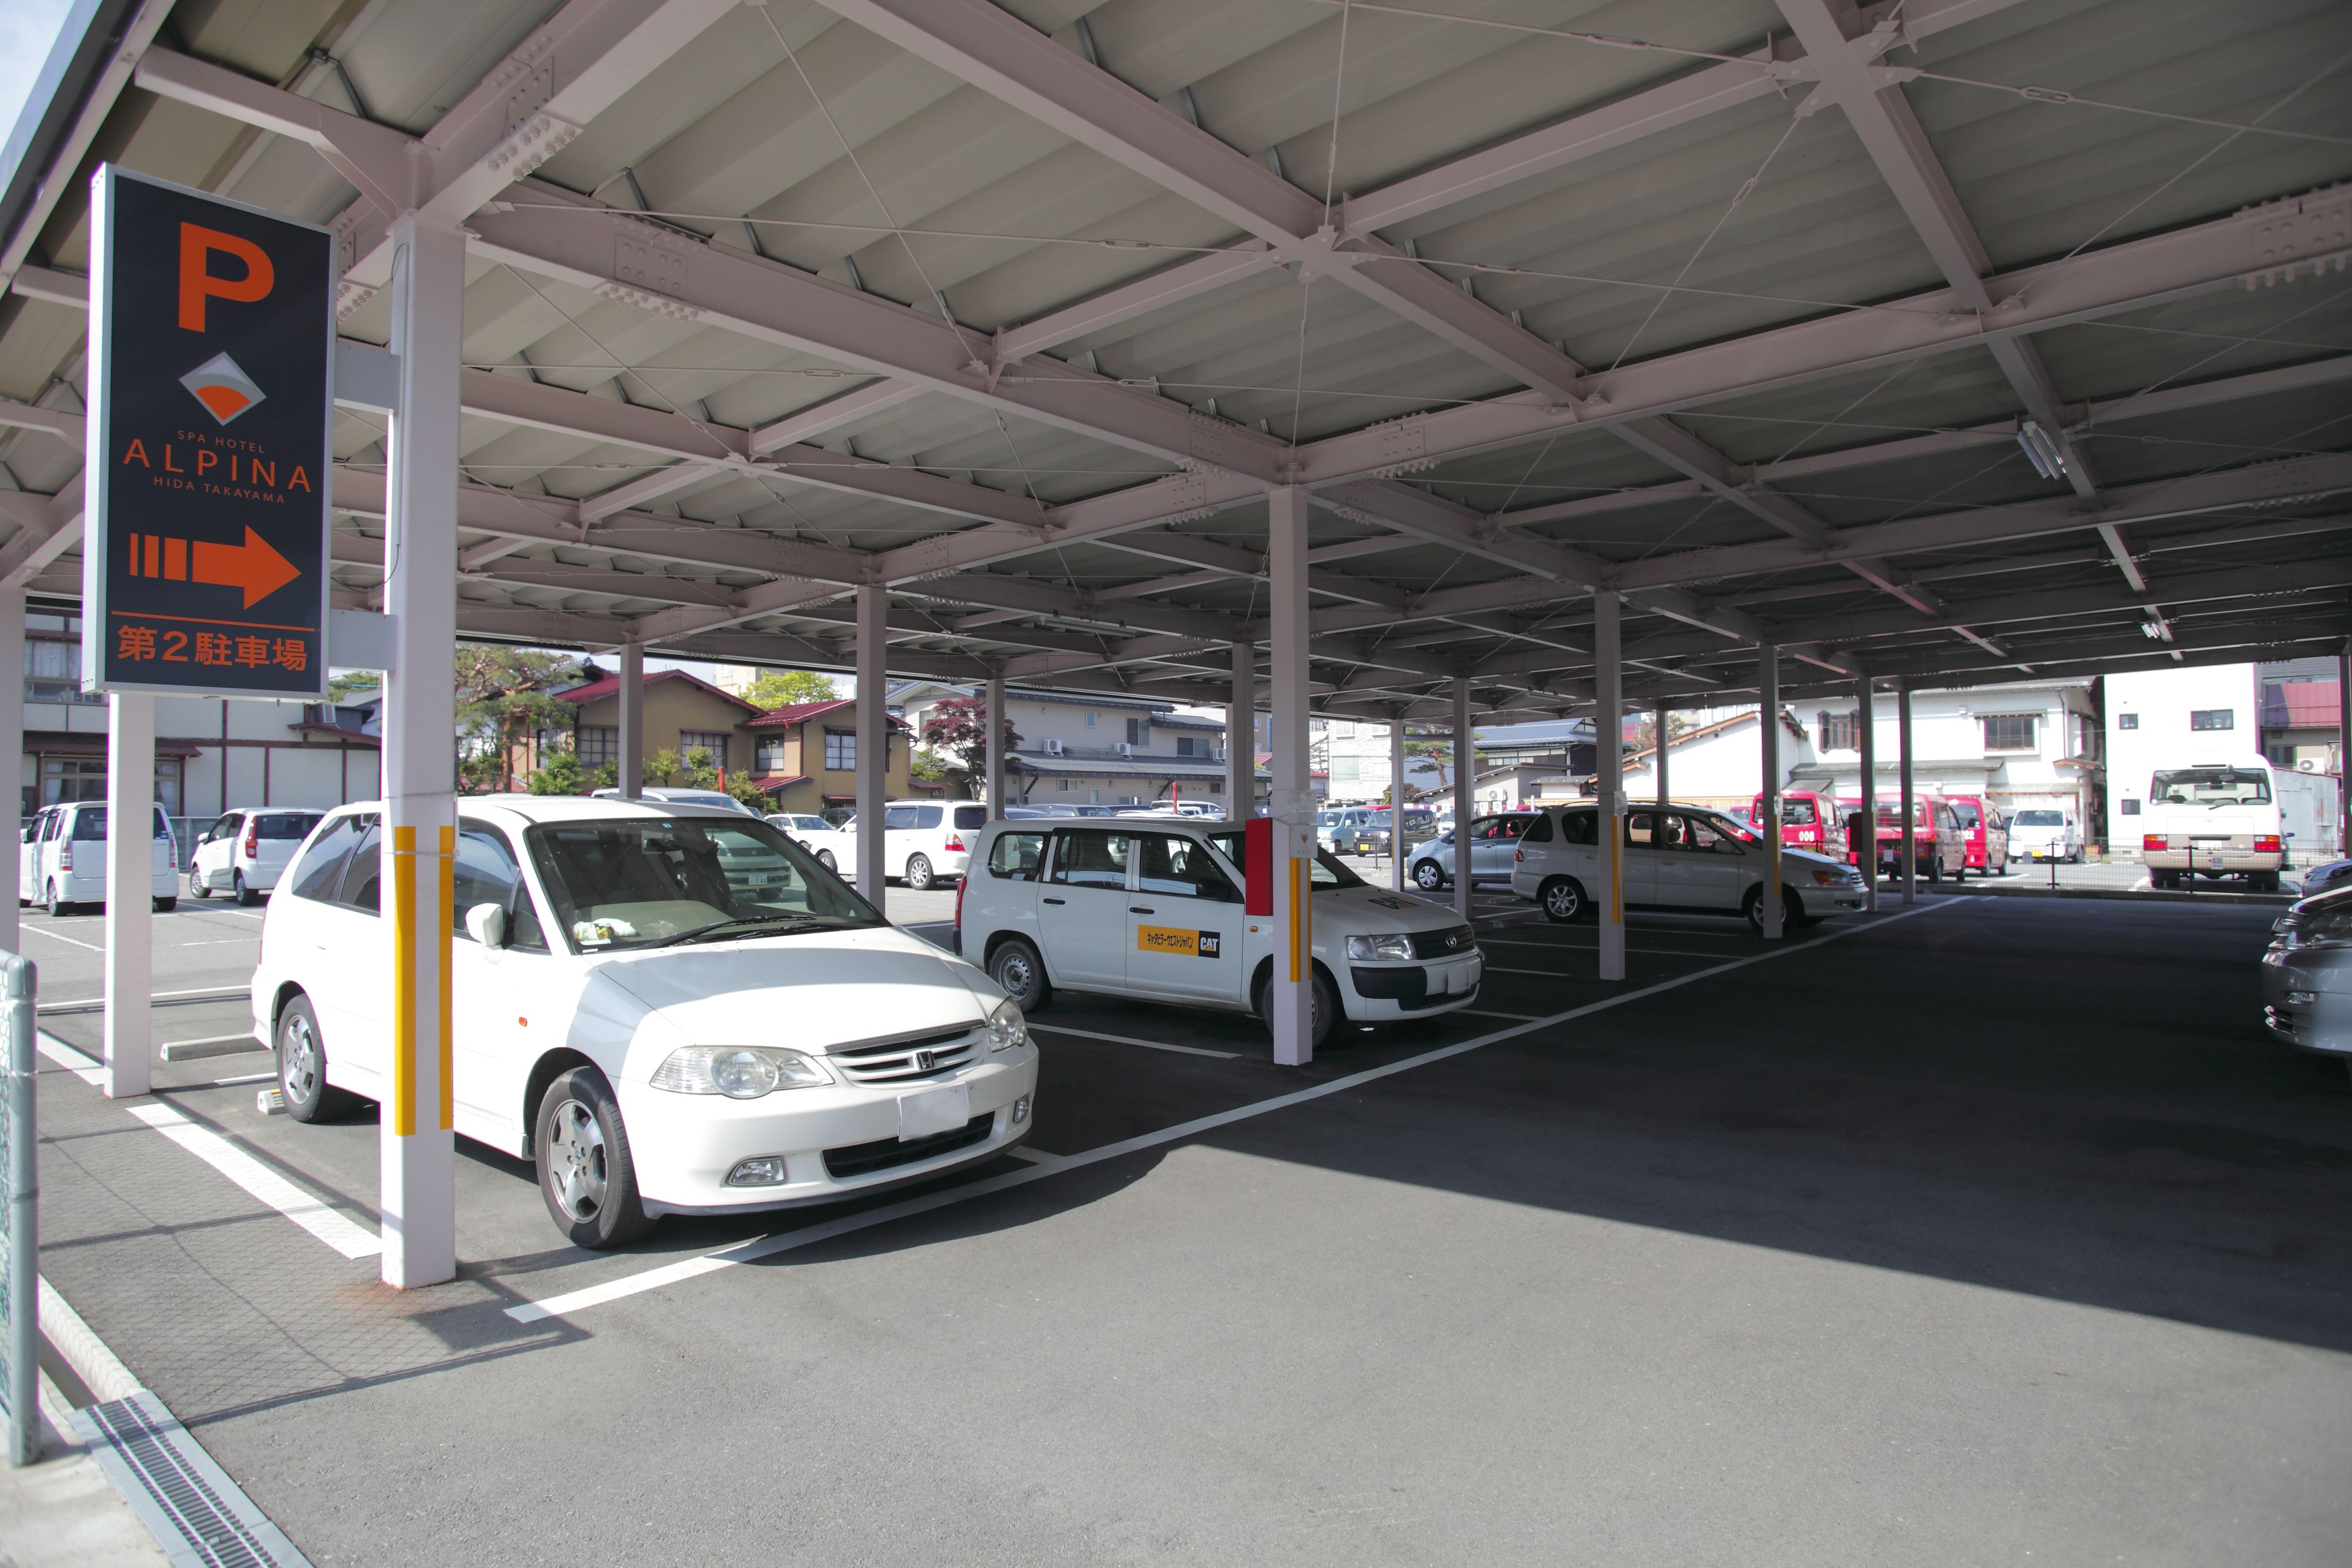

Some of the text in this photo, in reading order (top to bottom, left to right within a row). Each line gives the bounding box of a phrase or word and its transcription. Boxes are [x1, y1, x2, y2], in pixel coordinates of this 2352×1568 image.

[178, 221, 274, 333] P
[178, 430, 265, 454] SPA HOTEL
[123, 439, 311, 492] ALPINA
[154, 477, 285, 504] HIDA TAKAYAMA
[118, 624, 307, 671] 第2駐車場
[1200, 937, 1218, 952] CAT
